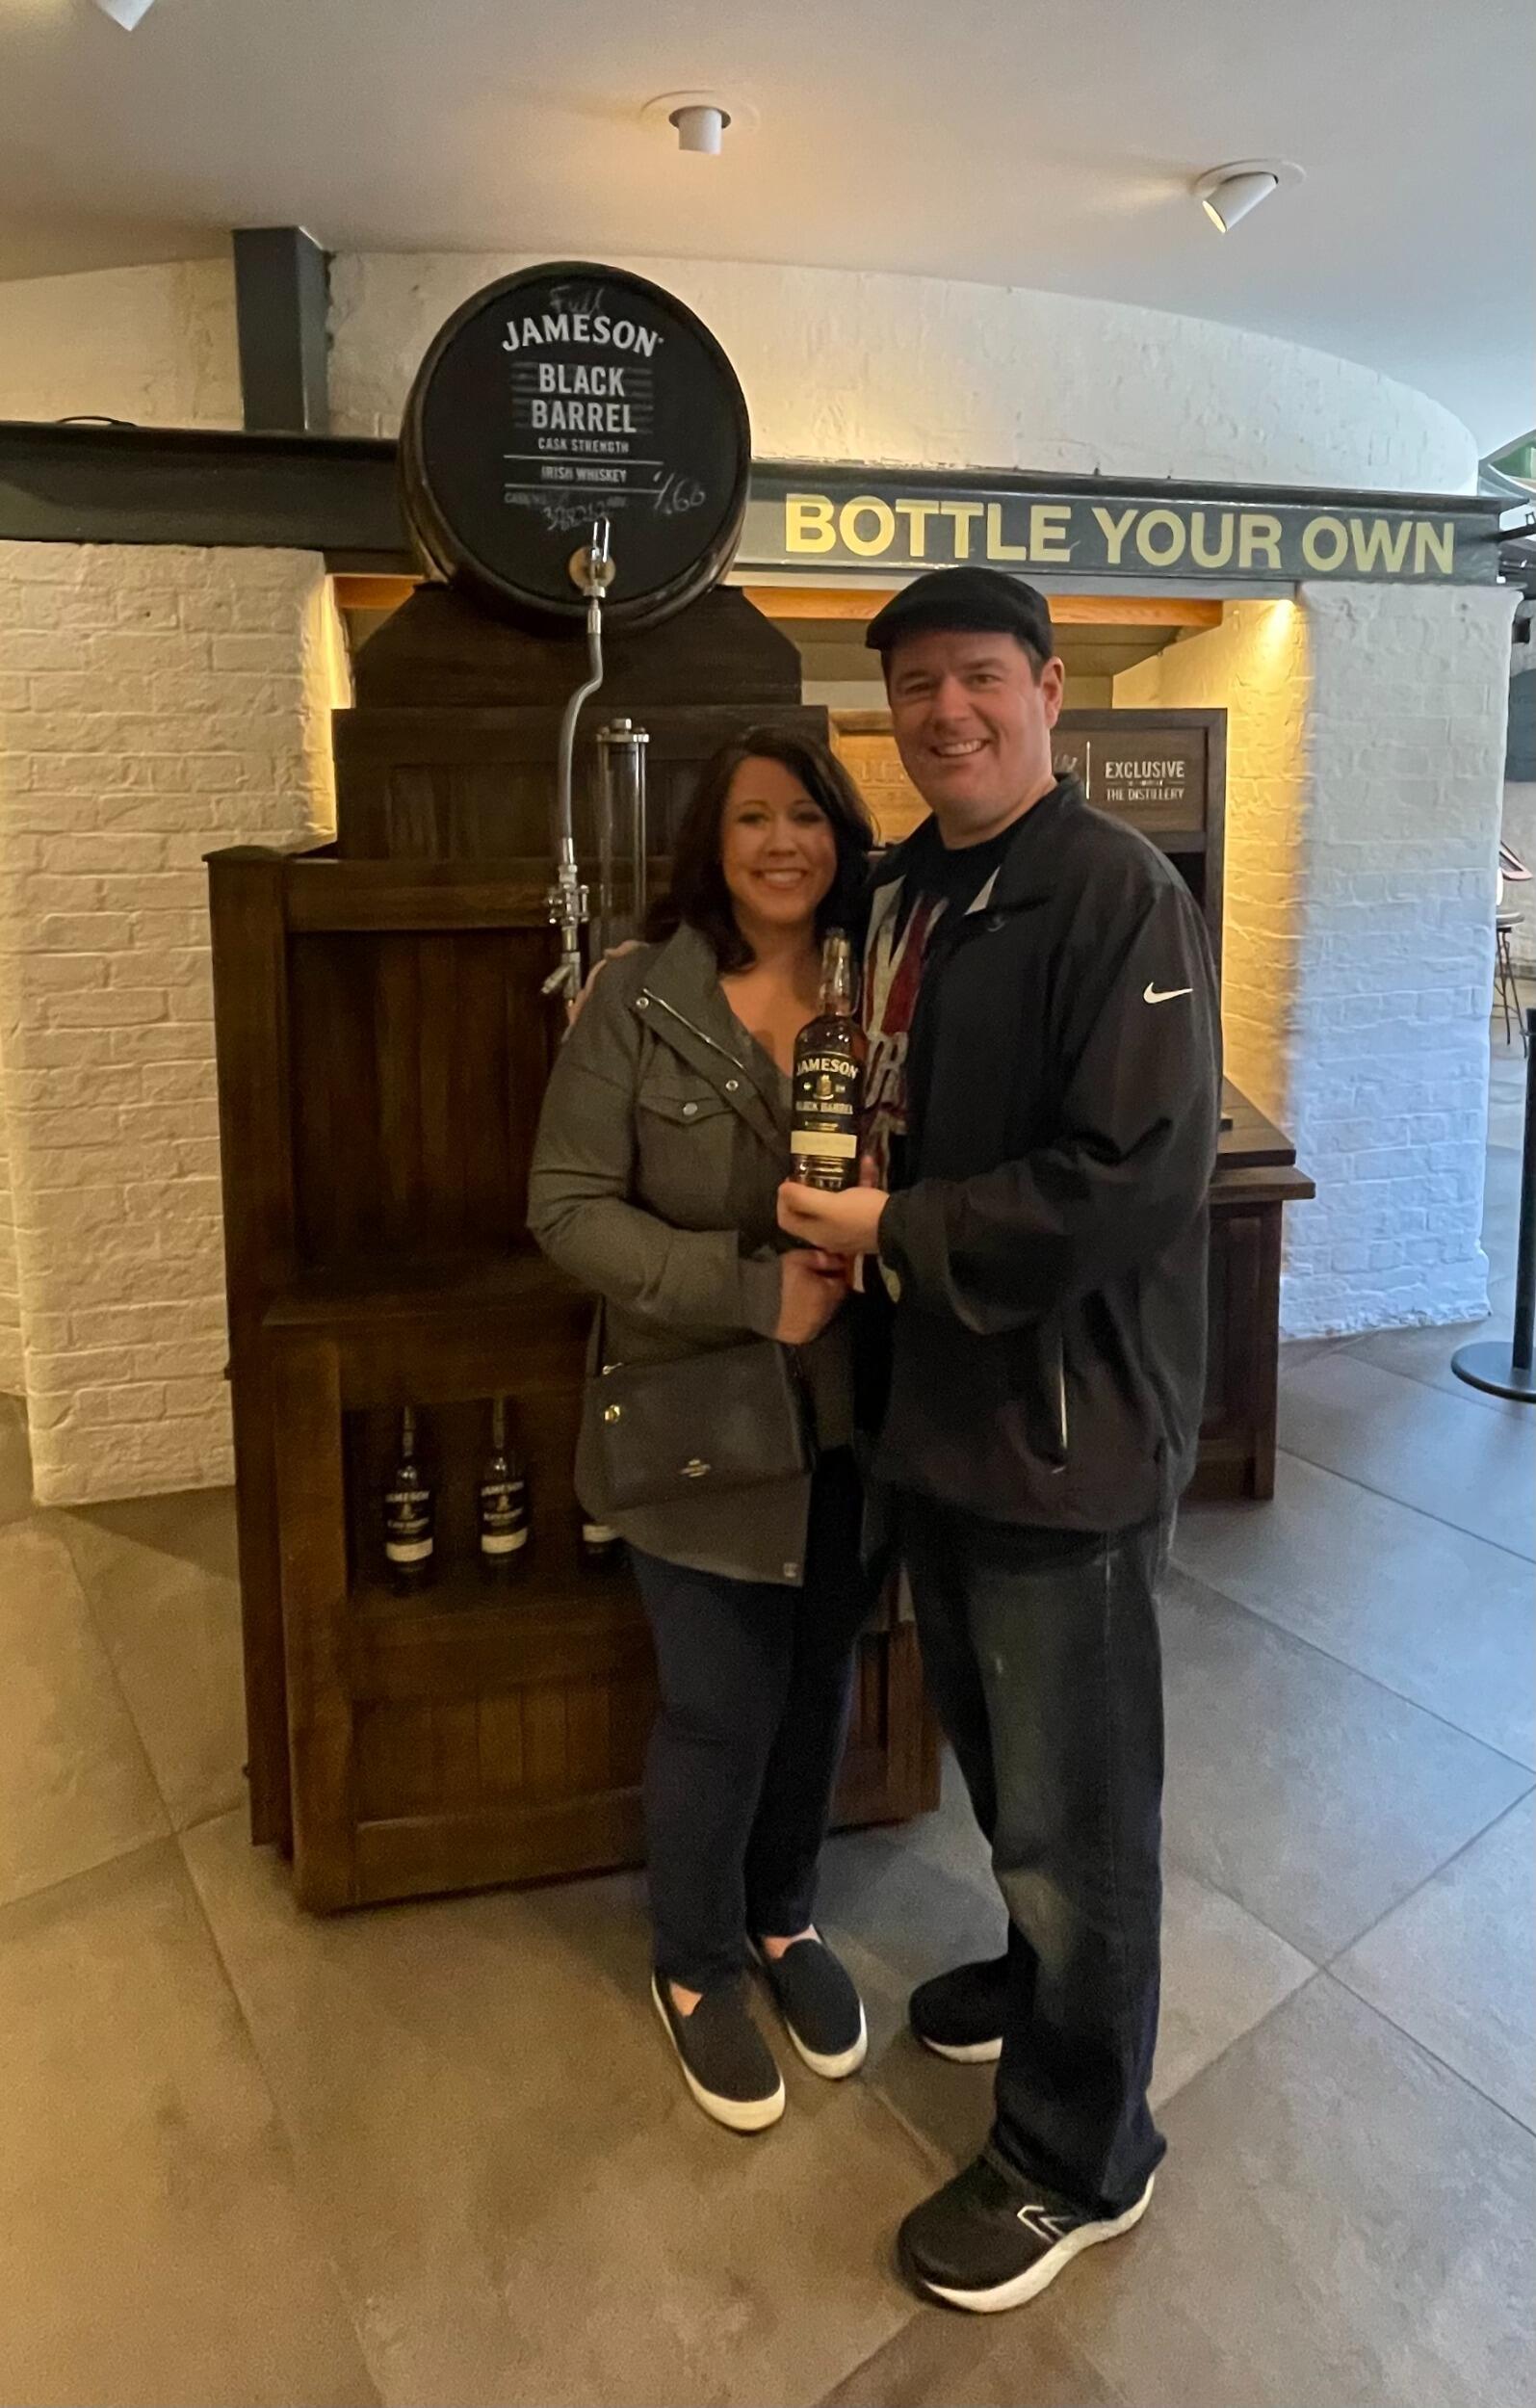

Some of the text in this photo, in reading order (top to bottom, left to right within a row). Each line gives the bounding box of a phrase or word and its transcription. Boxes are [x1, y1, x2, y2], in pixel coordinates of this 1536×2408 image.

[502, 313, 659, 357] JAMESON
[538, 362, 625, 397] BLACK
[532, 399, 637, 433] BARREL
[537, 436, 629, 454] CASK STRENGTH
[541, 465, 627, 483] IRISH WHISKEY
[784, 492, 1454, 574] BOTTLE YOUR OWN
[1105, 760, 1185, 778] EXCLUSIVE
[1106, 788, 1185, 801] THE DISTILLERY
[796, 1057, 859, 1080] JAMESON
